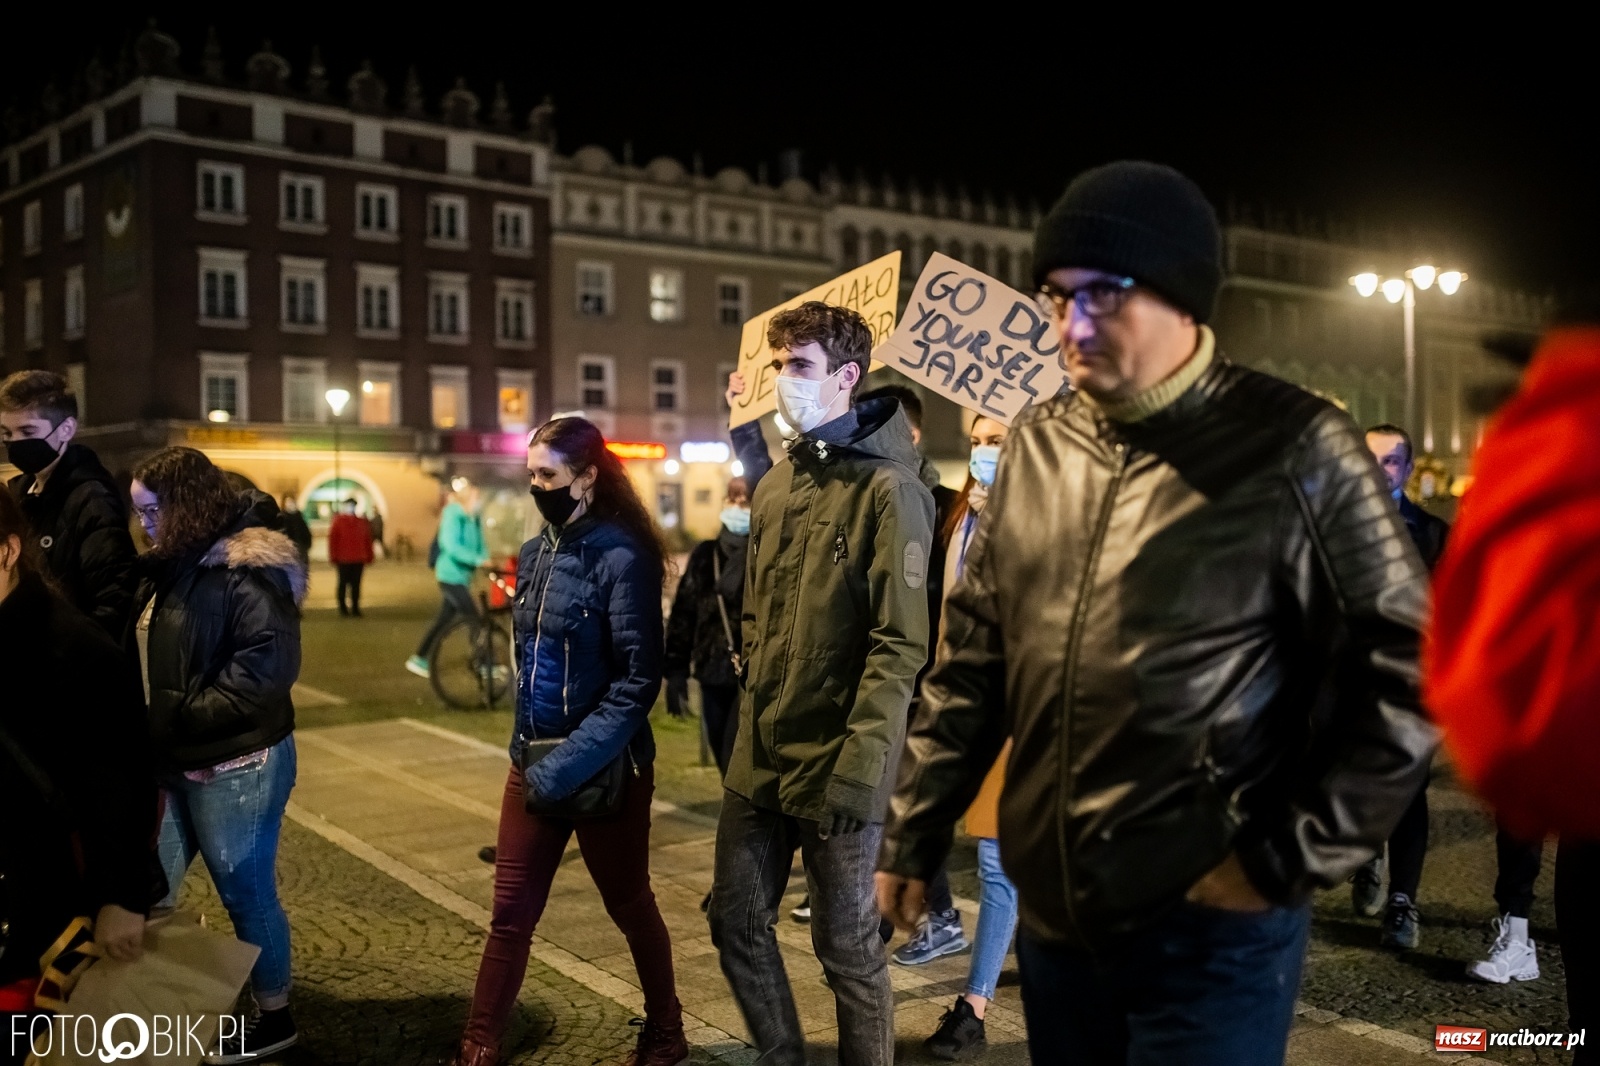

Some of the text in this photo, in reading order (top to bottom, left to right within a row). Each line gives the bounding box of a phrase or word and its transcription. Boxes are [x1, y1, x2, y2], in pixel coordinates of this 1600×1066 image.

[908, 302, 1070, 398] YOURSEL
[925, 270, 1068, 372] GO DU
[898, 339, 1034, 418] JARE
